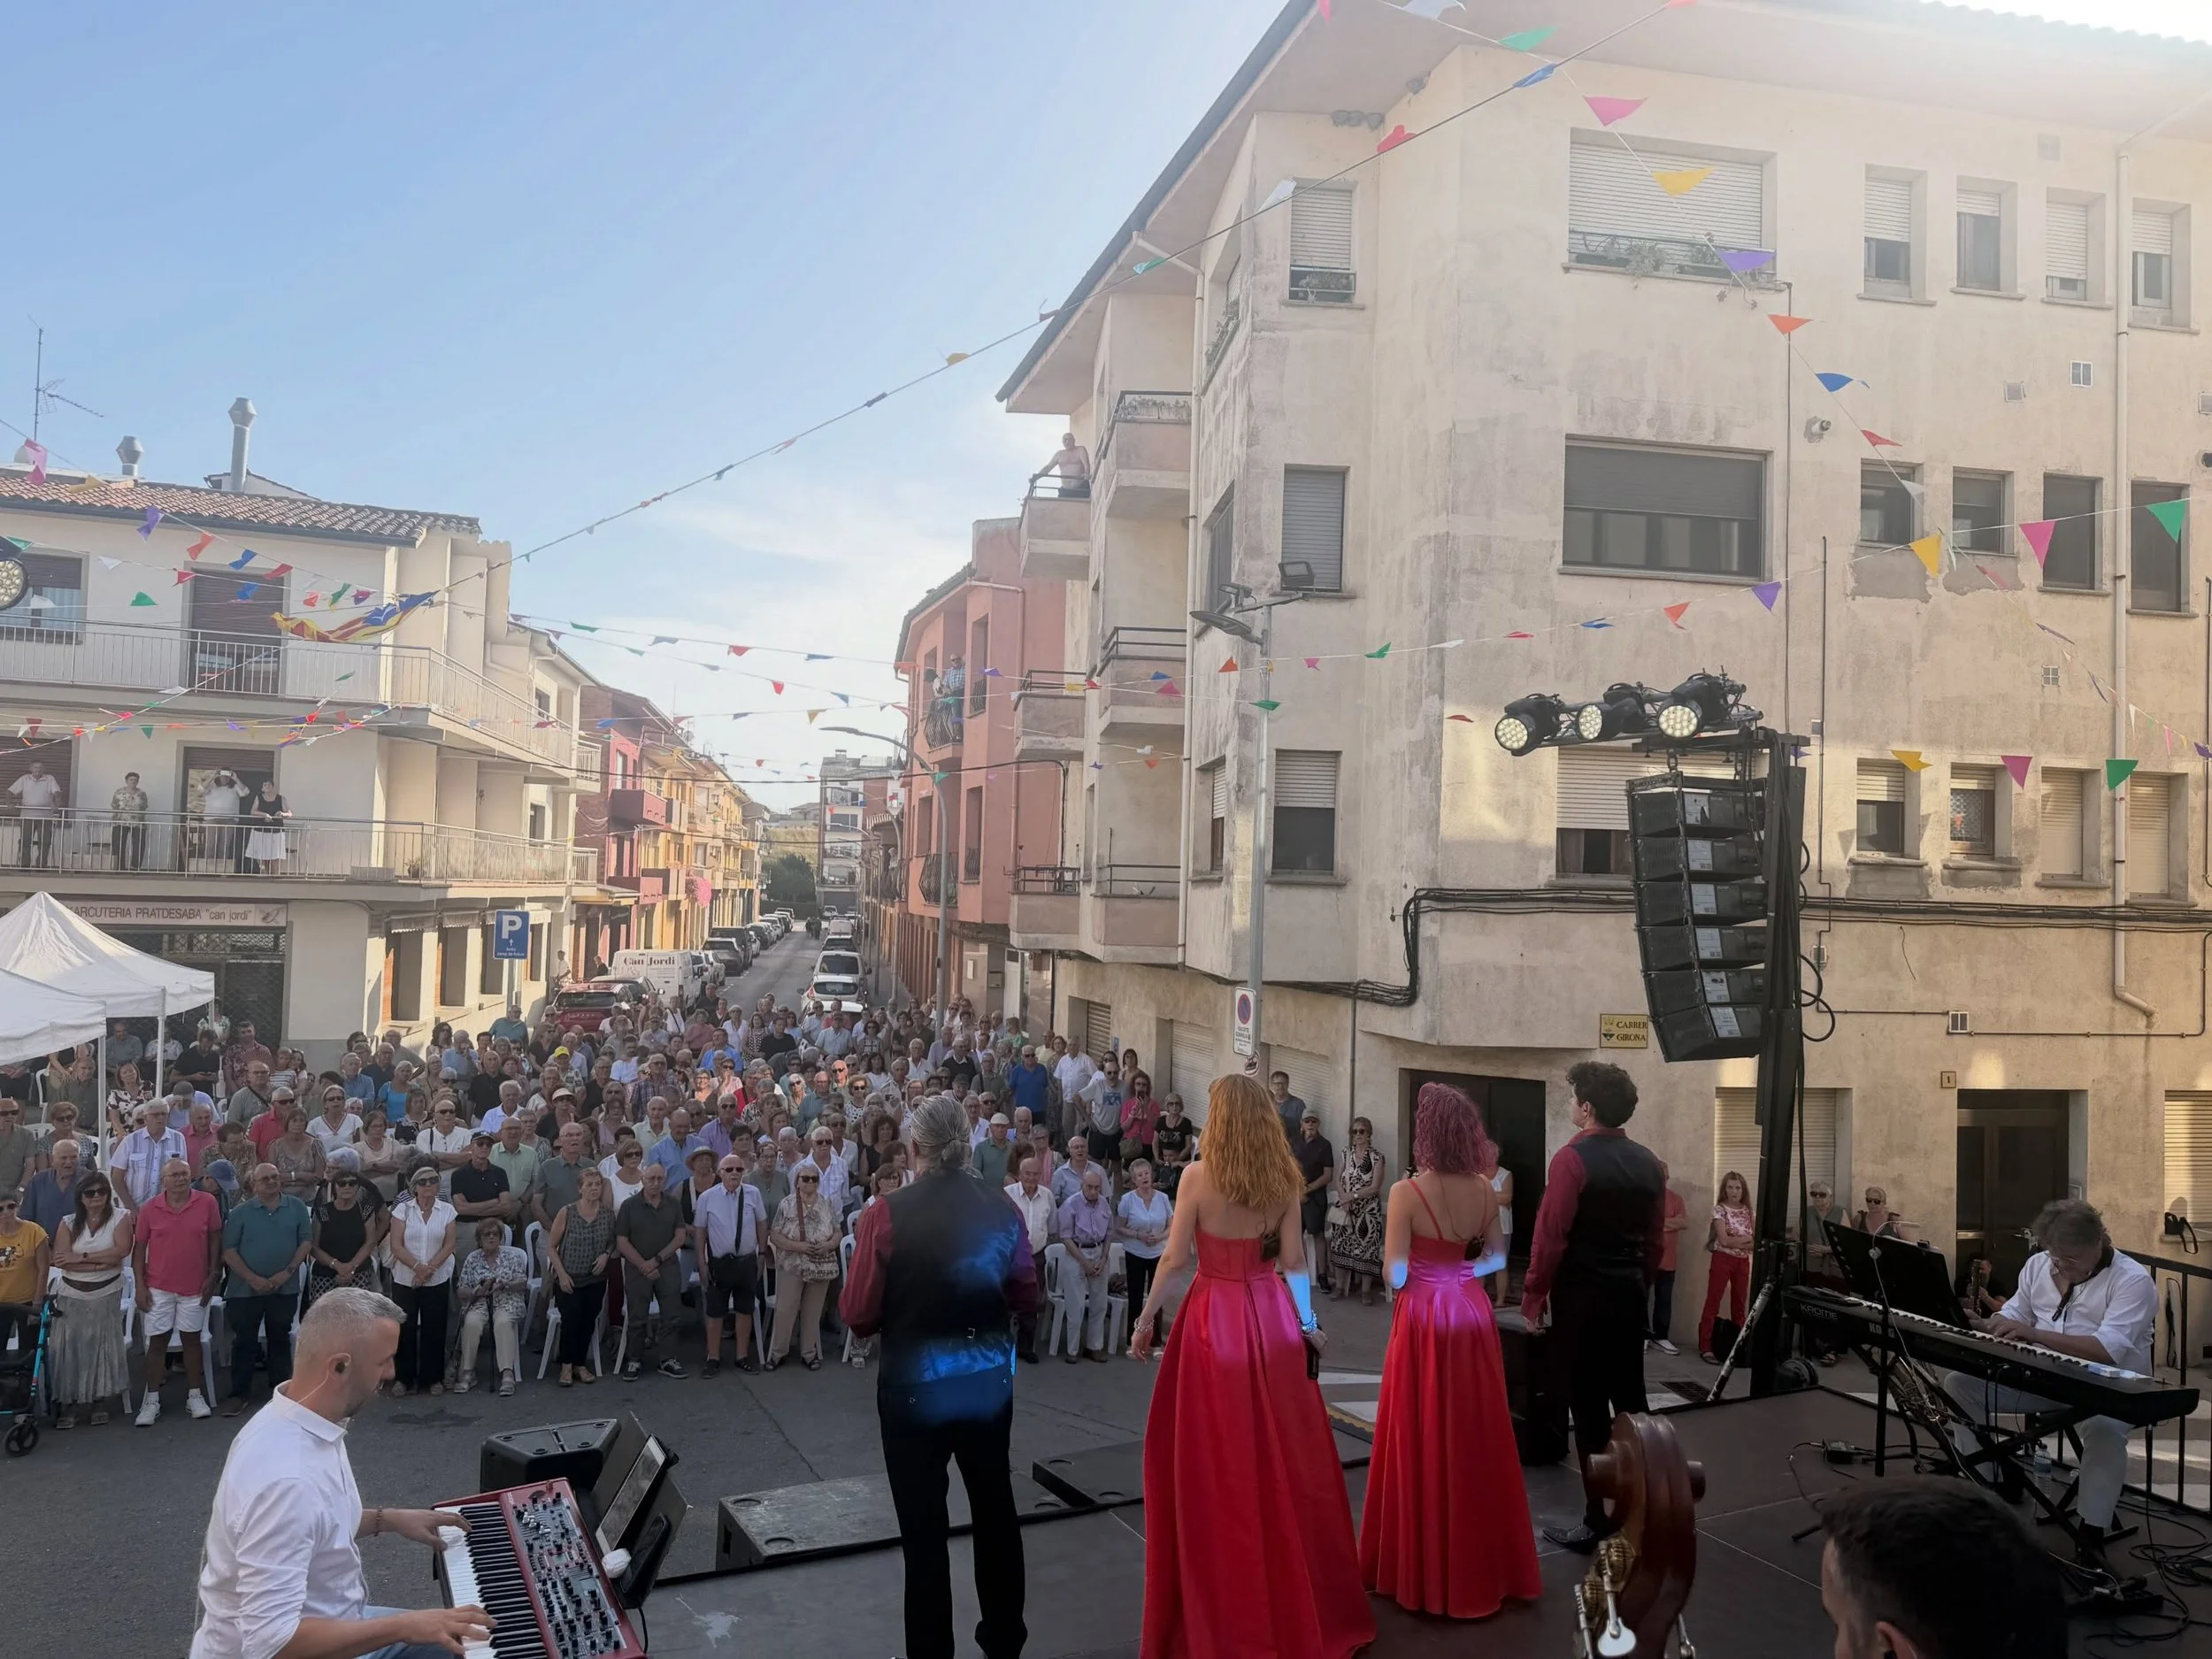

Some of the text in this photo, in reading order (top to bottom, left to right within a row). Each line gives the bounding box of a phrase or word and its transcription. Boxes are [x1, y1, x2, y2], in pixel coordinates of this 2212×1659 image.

[135, 907, 202, 919] PRATDESABA
[502, 914, 522, 939] P
[624, 956, 675, 966] Can Jordi
[1869, 1322, 1895, 1339] KOG
